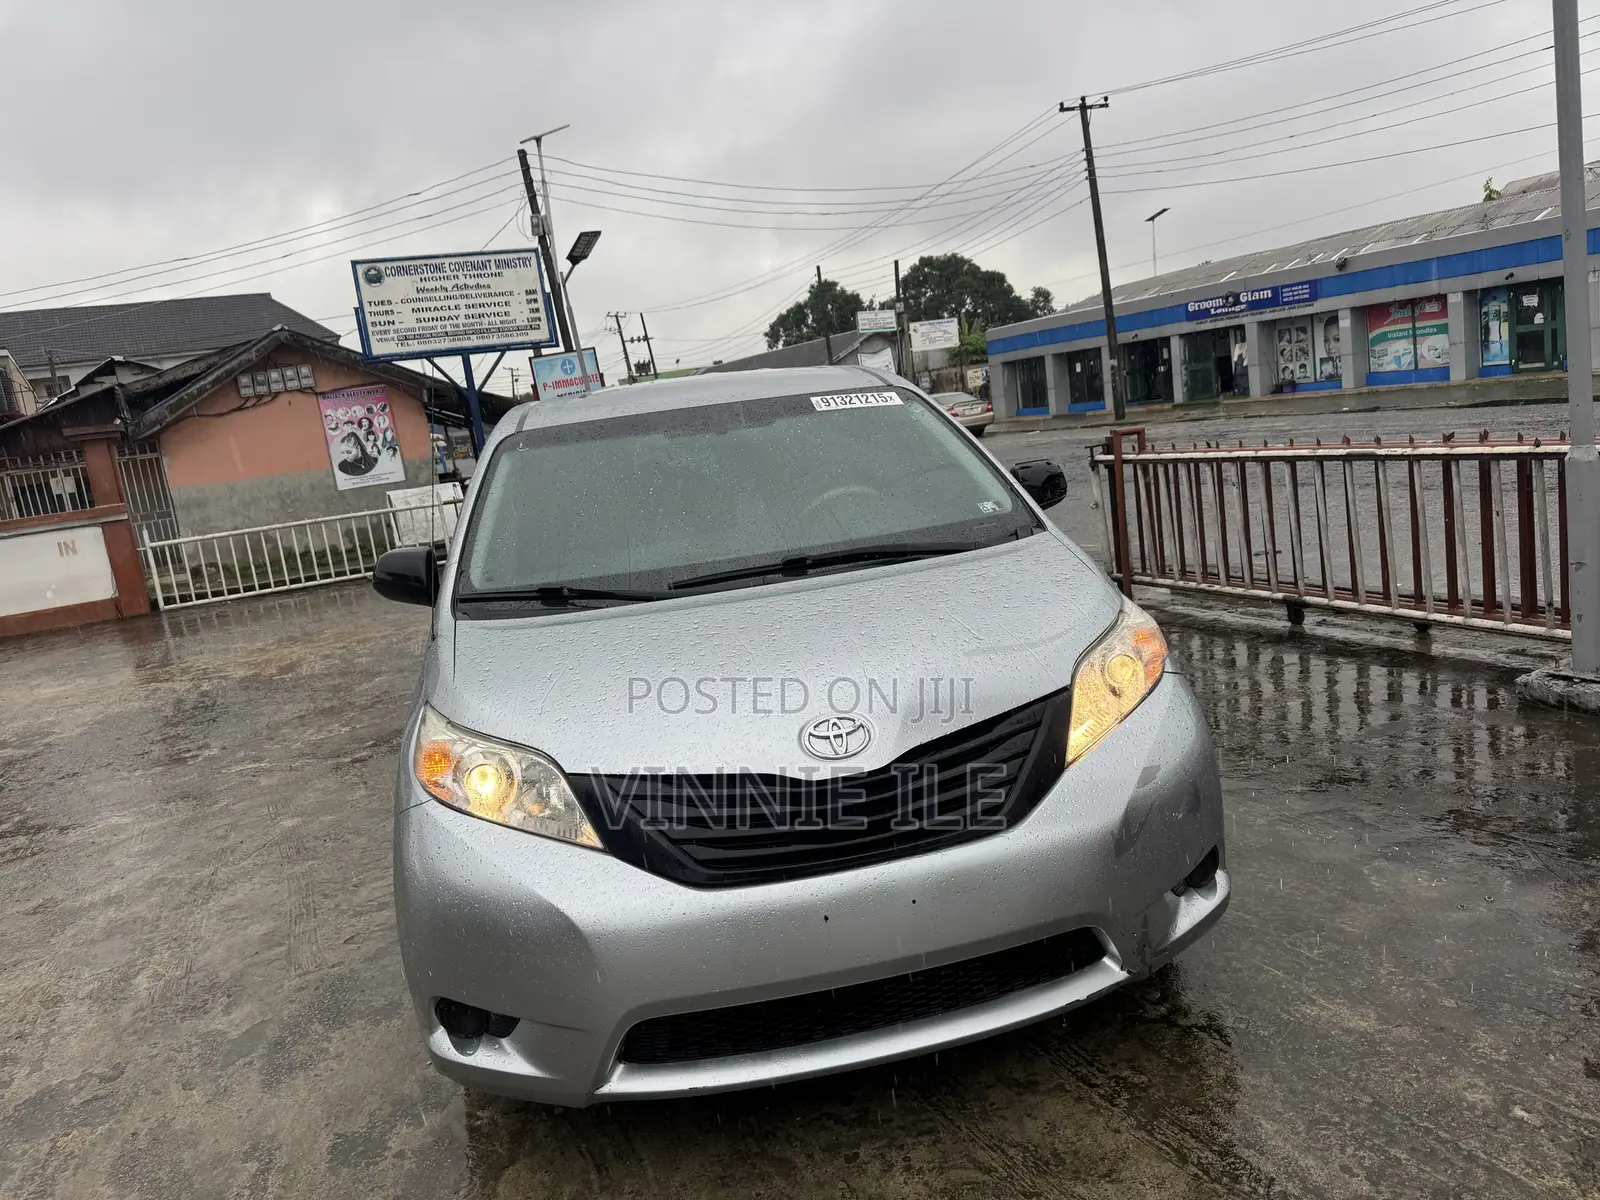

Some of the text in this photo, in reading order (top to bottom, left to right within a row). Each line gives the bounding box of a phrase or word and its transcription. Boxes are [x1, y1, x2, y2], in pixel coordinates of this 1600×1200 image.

[384, 256, 532, 277] CORNERSTONE COVENANT MINISTRY
[420, 271, 504, 282] HIGHER THRONE
[416, 282, 492, 294] Weekly Activities
[400, 290, 515, 305] COUNSELLING/DELIVERANCE
[1188, 297, 1222, 312] Groom
[1240, 289, 1272, 302] Glam
[368, 309, 394, 317] THURS
[412, 304, 461, 314] MIRACLE
[464, 300, 511, 310] SERVICE
[1210, 304, 1247, 315] Lounge
[370, 320, 396, 328] SUN
[416, 314, 460, 324] SUNDAY
[464, 311, 511, 320] SERVICE
[393, 326, 417, 334] SECOND
[418, 324, 439, 332] FRIDAY
[542, 374, 600, 392] P-IMMACUATE
[57, 540, 78, 557] IN
